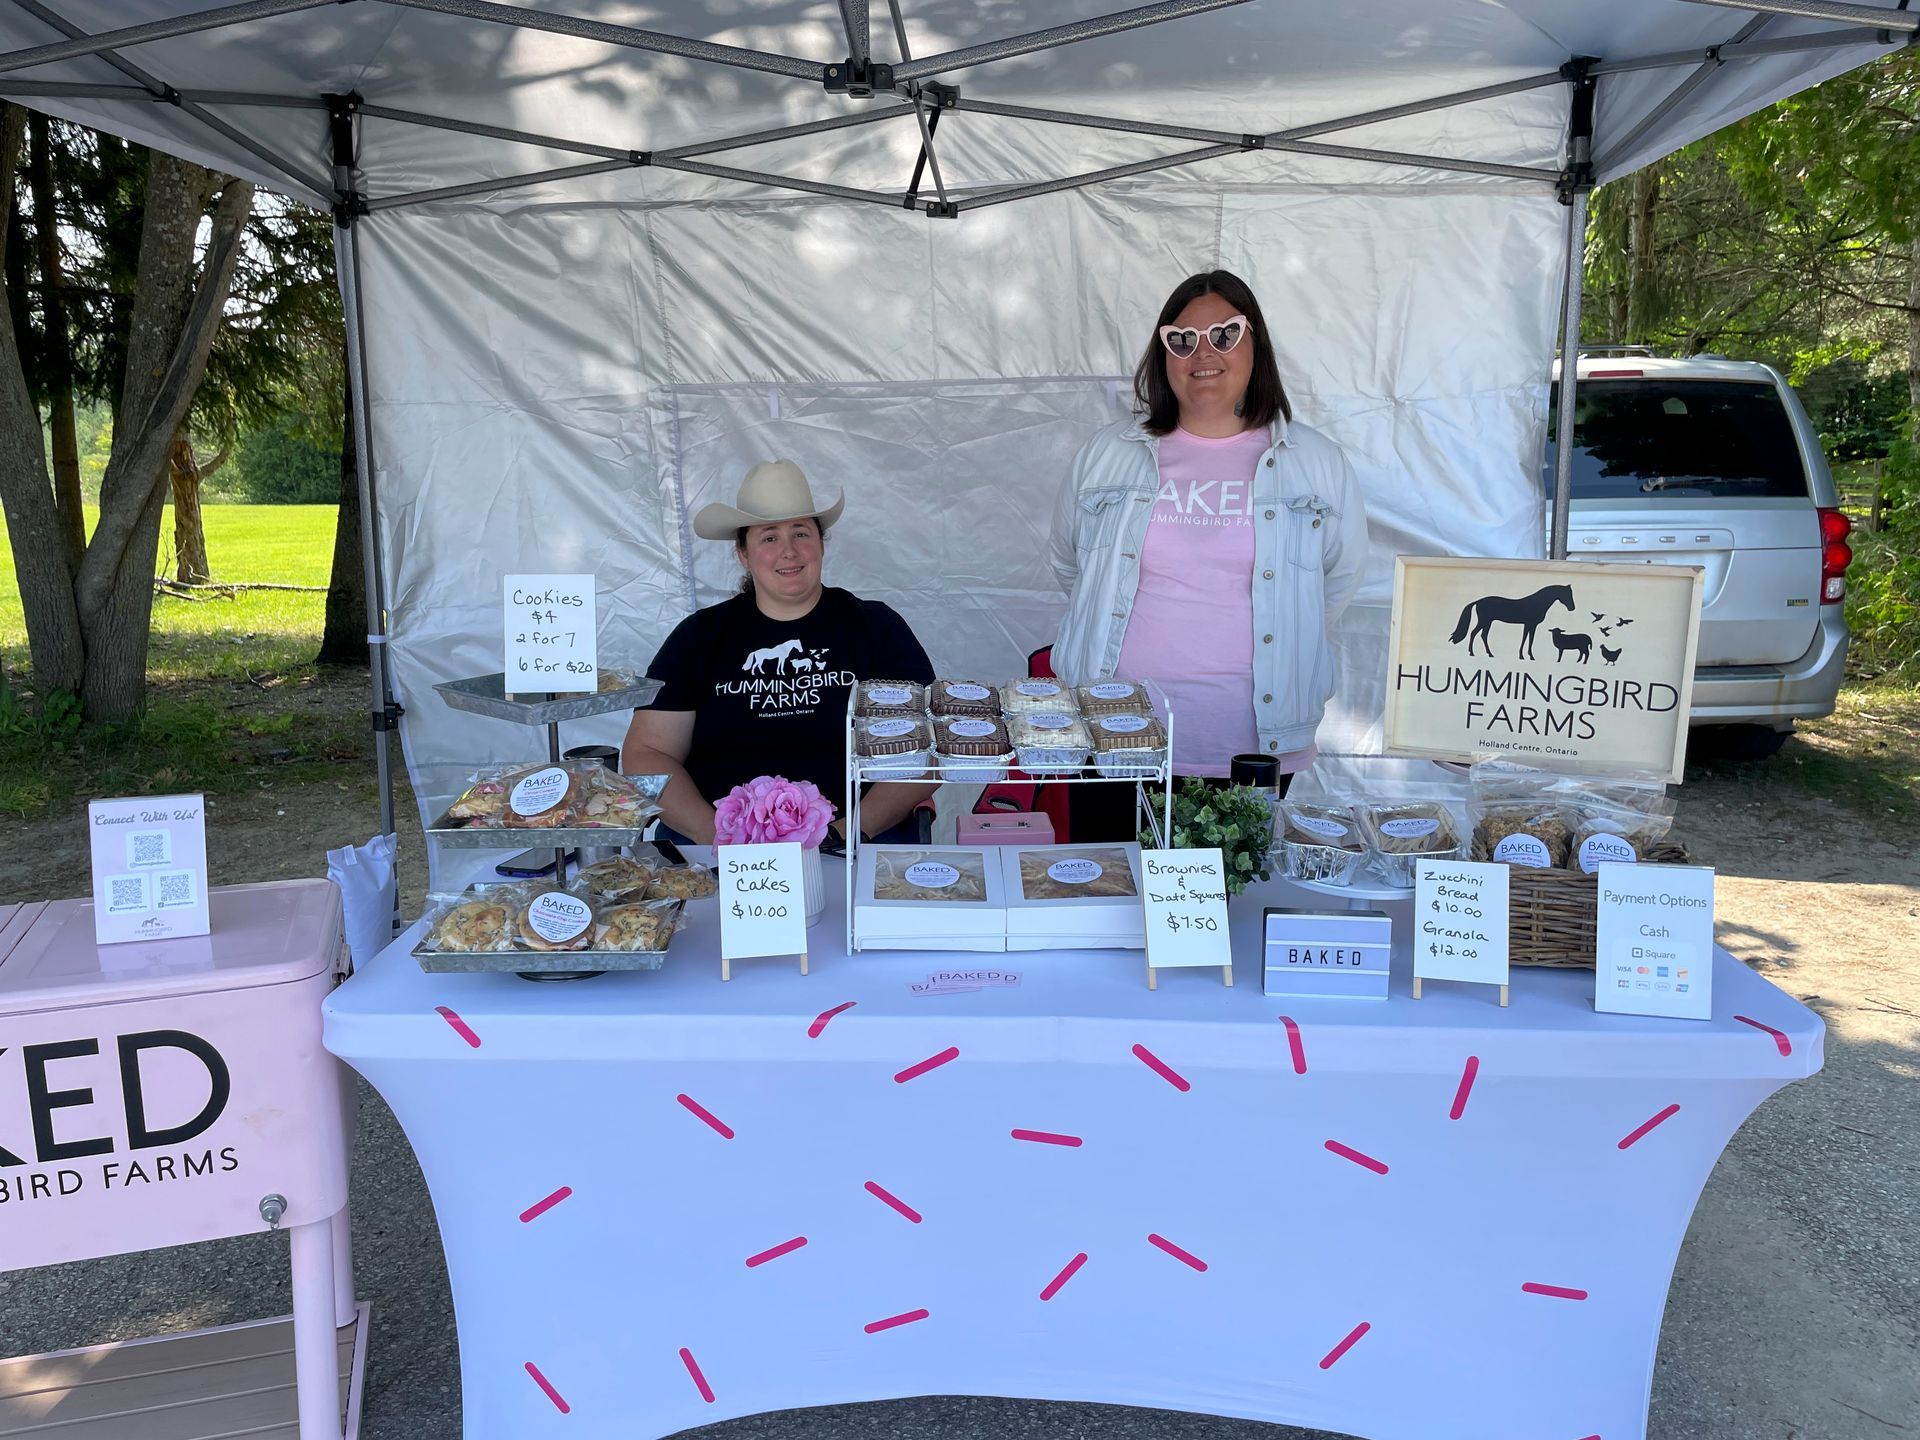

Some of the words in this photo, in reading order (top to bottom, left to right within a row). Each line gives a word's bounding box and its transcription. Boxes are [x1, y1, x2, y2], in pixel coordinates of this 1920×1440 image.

[513, 589, 583, 607] Cookies
[531, 610, 557, 625] $4
[515, 633, 526, 643] 2
[532, 631, 560, 644] for
[565, 632, 576, 648] 7
[519, 657, 528, 672] 6
[534, 657, 560, 672] for
[566, 660, 593, 674] $20
[715, 670, 856, 697] HUMMINGBIRD
[1397, 663, 1679, 713] HUMMINGBIRD
[750, 689, 821, 710] FARMS
[1466, 702, 1597, 740] FARMS
[1478, 739, 1510, 750] Holland
[1545, 745, 1578, 756] Ontario
[523, 773, 563, 788] BAKED
[95, 813, 135, 826] Connect
[140, 811, 168, 823] With
[173, 809, 198, 821] Us!
[1501, 843, 1542, 854] BAKED
[1588, 841, 1630, 857] BAKED
[728, 858, 778, 874] Snack
[1147, 859, 1217, 875] Brownies
[737, 877, 790, 893] Cakes
[1424, 871, 1484, 887] Zucchini
[1149, 892, 1186, 903] Date
[1189, 889, 1226, 904] Squares
[1438, 885, 1479, 902] Bread
[1604, 889, 1657, 906] Payment
[1659, 893, 1707, 909] Options
[542, 896, 585, 916] BAKED
[1423, 921, 1489, 942] Granola
[1639, 924, 1670, 938] Cash
[1289, 948, 1361, 966] BAKED
[1430, 942, 1478, 958] $12.00
[1645, 949, 1676, 960] Square
[939, 972, 1000, 980] BAKED
[1616, 965, 1632, 973] VISA
[103, 1147, 240, 1190] FARMS
